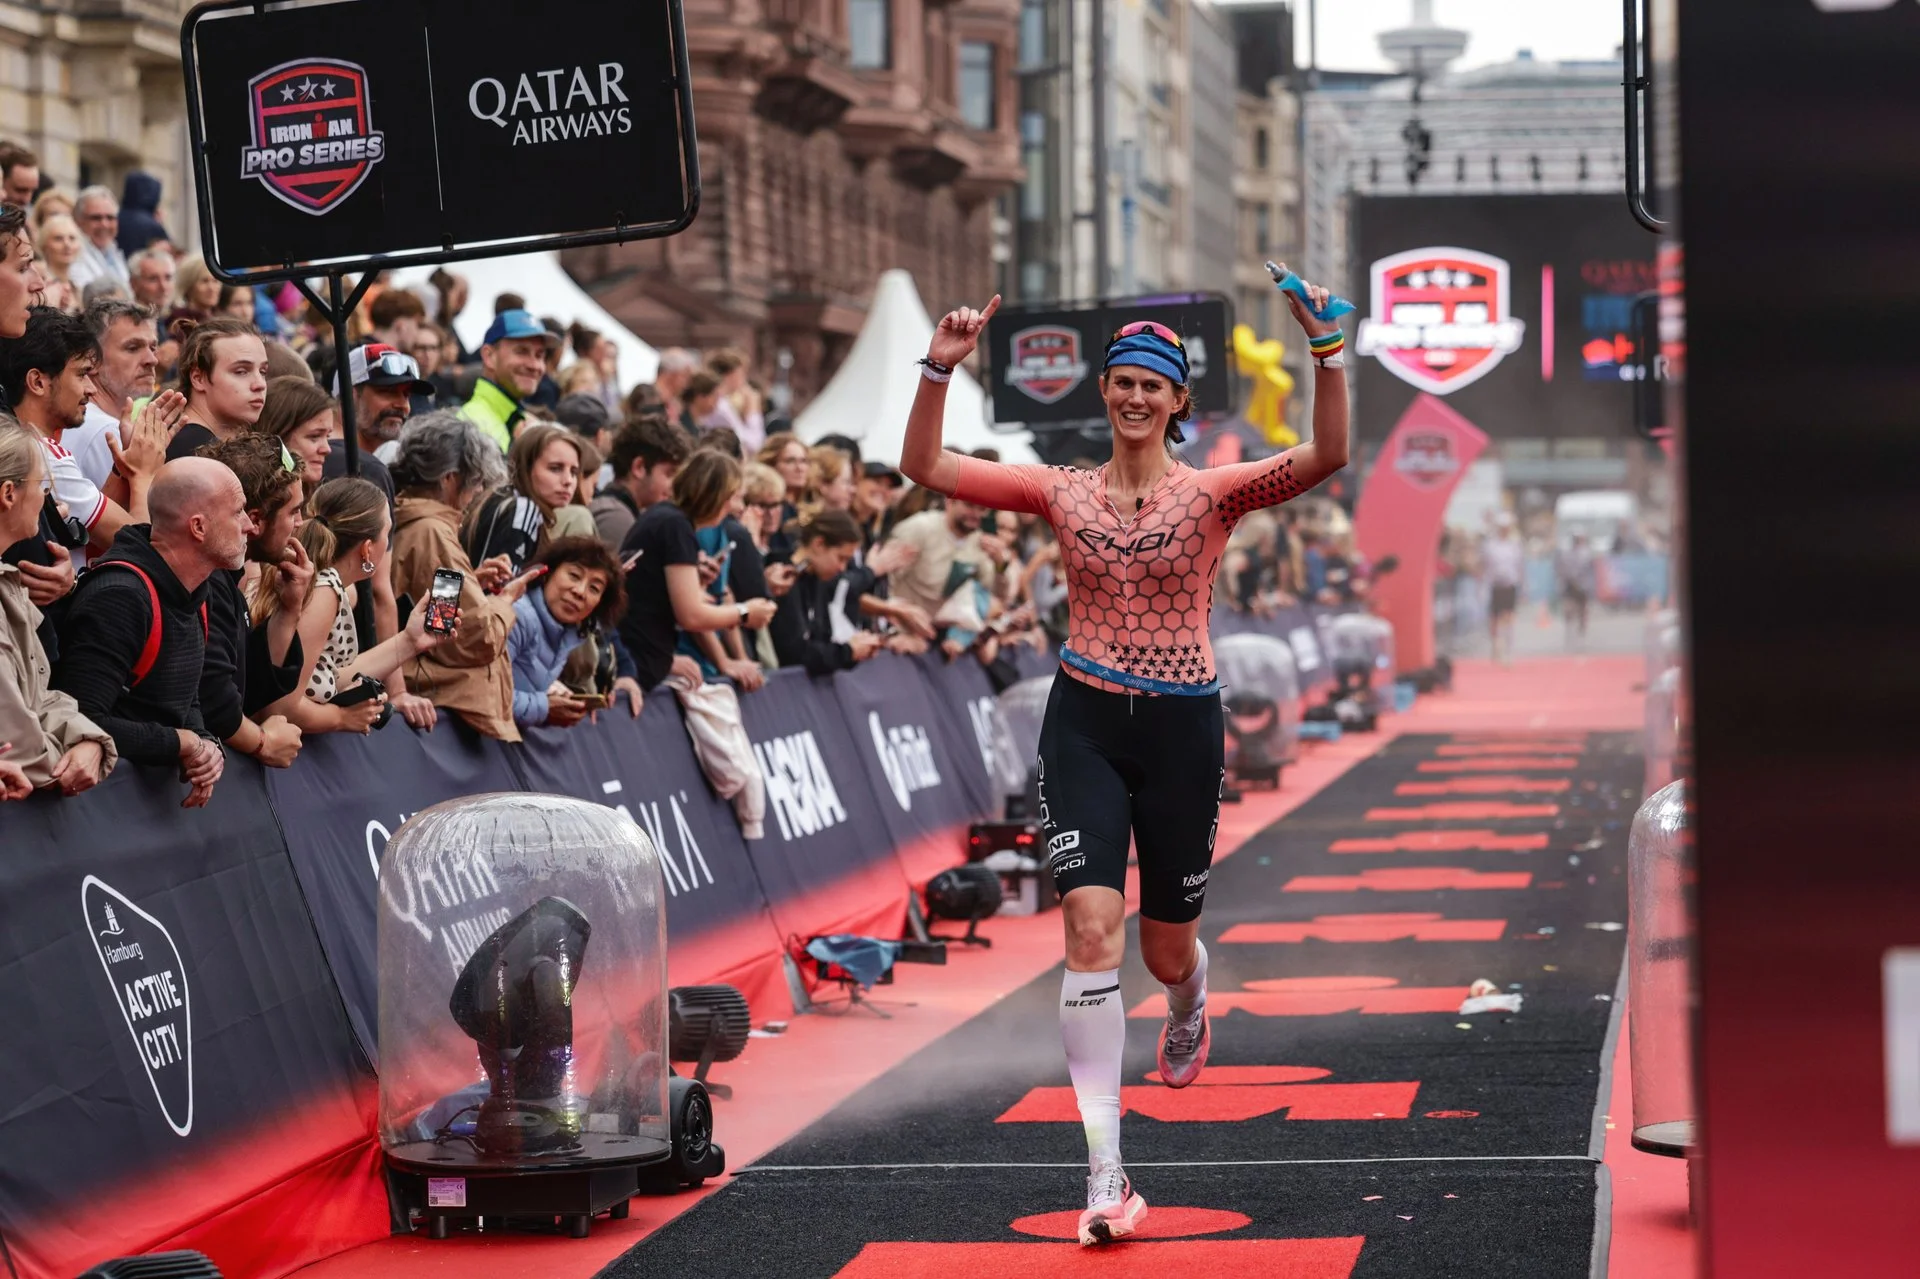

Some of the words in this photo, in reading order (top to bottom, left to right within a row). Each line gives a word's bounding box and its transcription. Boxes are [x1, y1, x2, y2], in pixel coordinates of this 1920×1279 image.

[468, 61, 630, 128] QATAR
[270, 111, 353, 144] IRONMAN
[512, 107, 632, 146] AIRWAYS
[246, 146, 295, 172] PRO
[298, 136, 383, 166] SERIES
[1123, 676, 1154, 689] sailfish
[753, 730, 848, 842] HOKA
[104, 941, 144, 965] Hamburg
[125, 970, 182, 1022] ACTIVE
[1079, 996, 1106, 1007] cep
[142, 1022, 182, 1070] CITY
